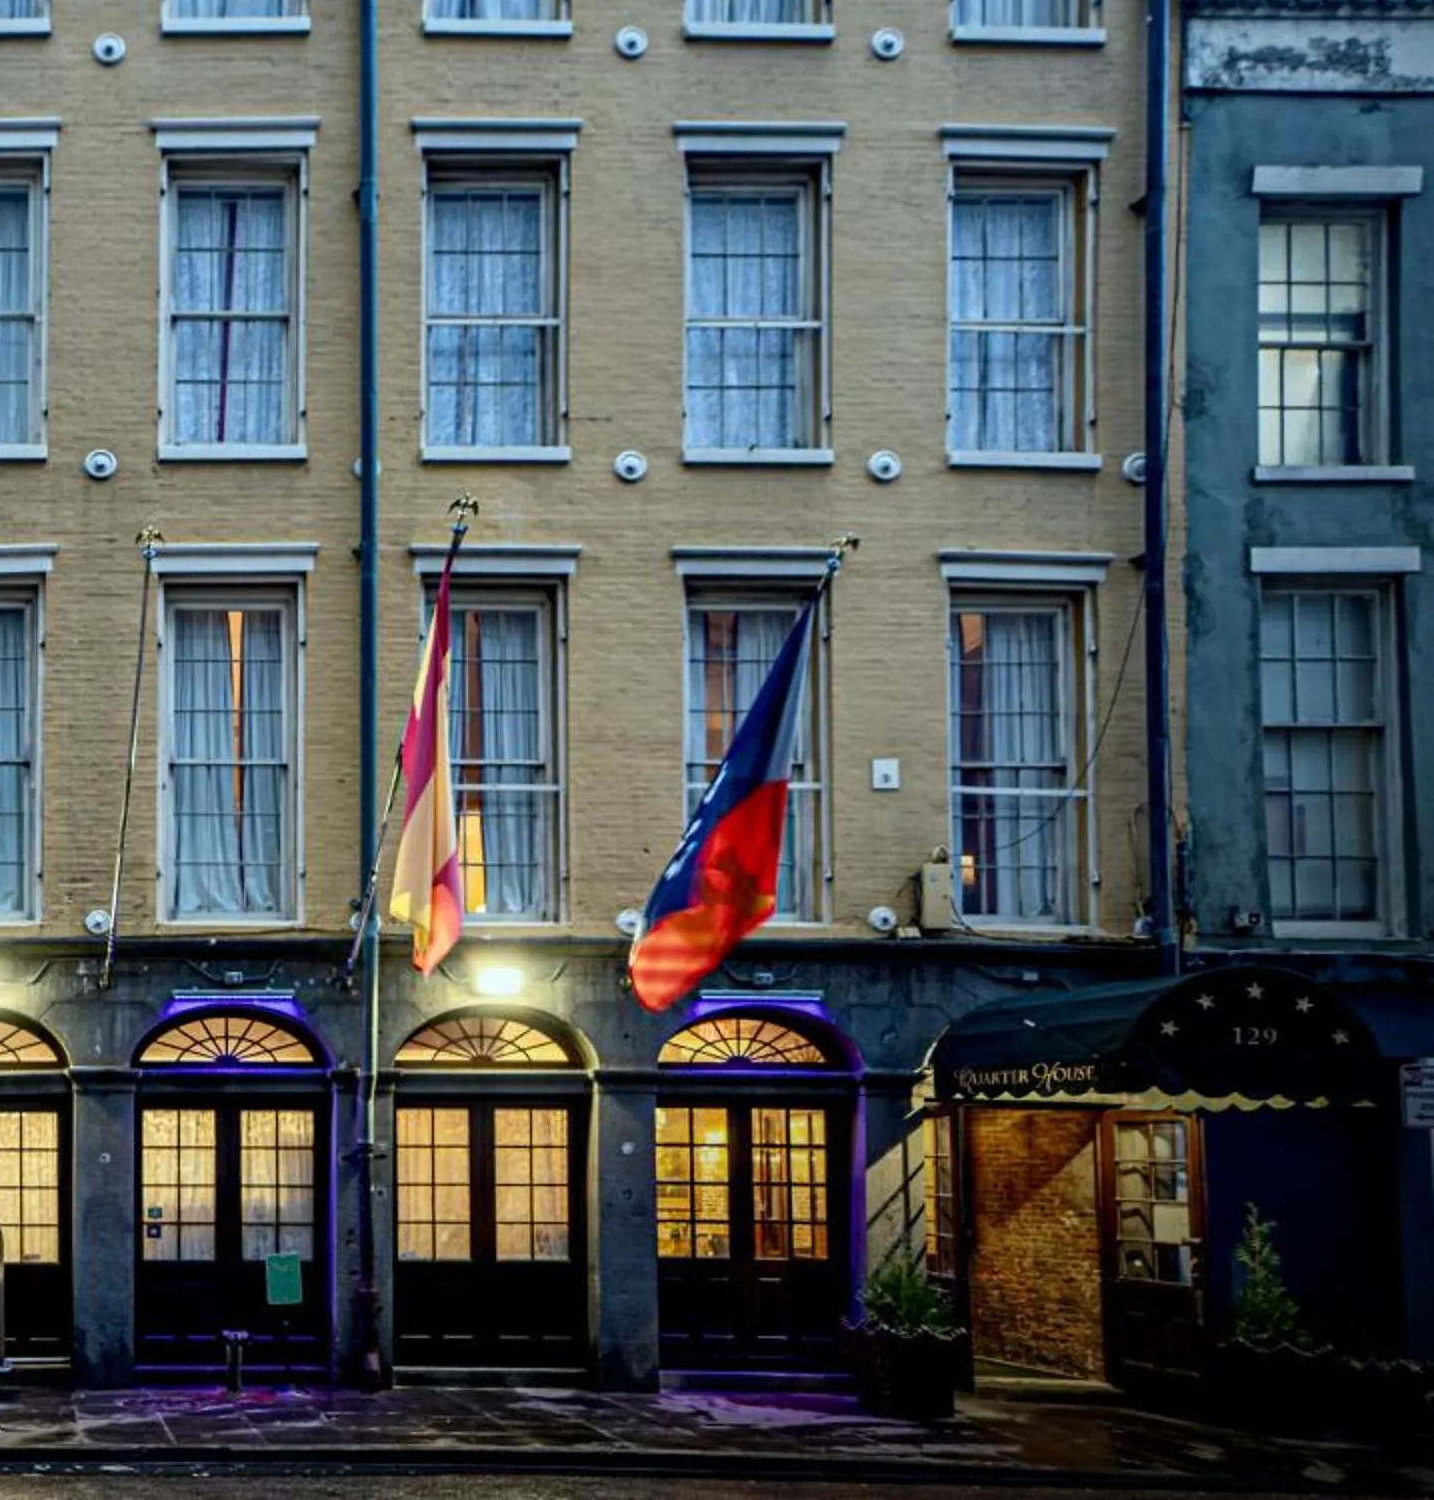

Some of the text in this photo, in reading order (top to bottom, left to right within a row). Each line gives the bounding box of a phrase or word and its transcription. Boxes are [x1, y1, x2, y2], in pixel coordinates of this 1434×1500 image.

[1232, 1025, 1279, 1047] 129
[954, 1060, 1096, 1094] QUARTER HOUSE
